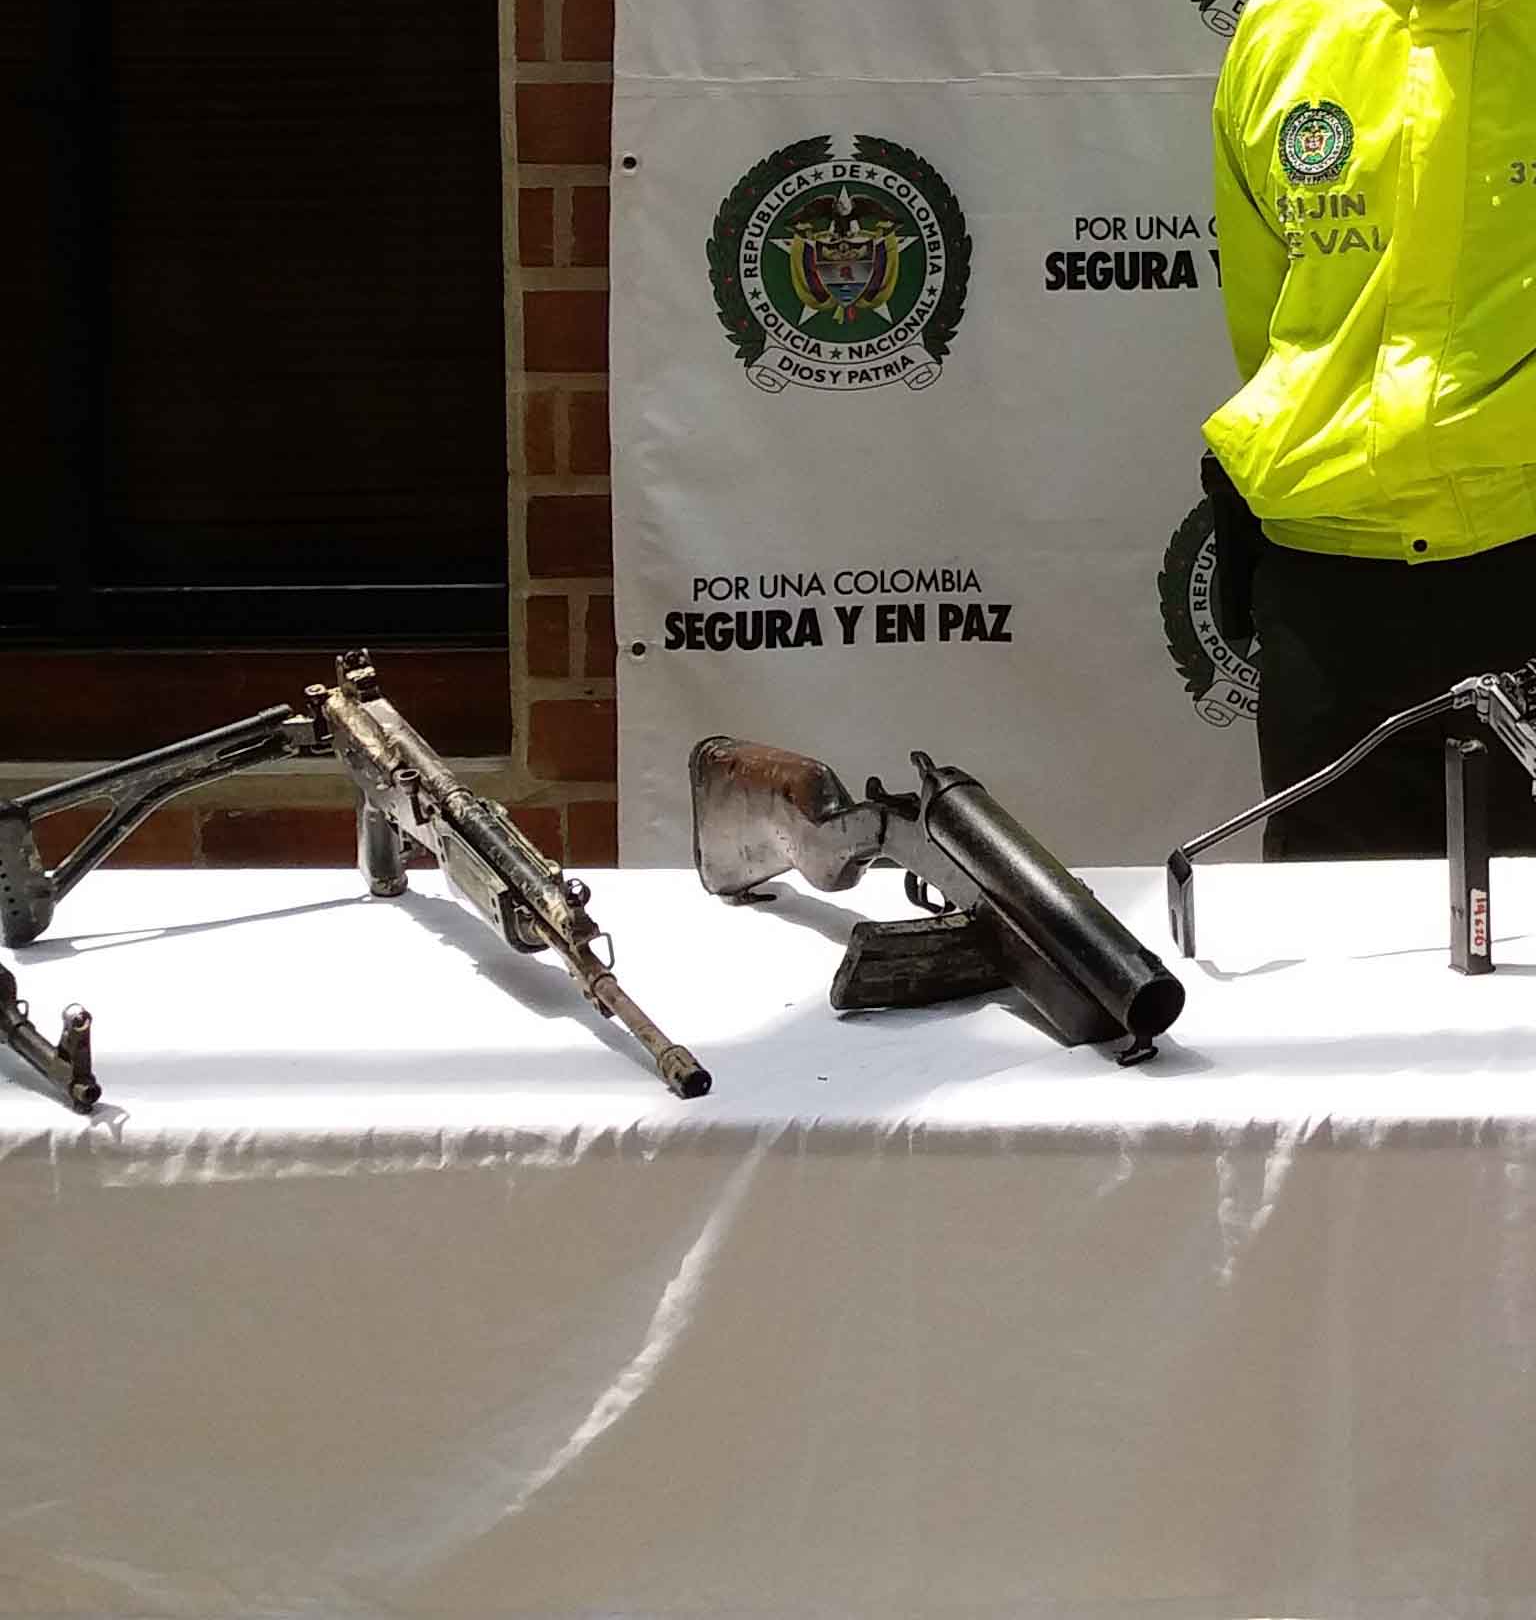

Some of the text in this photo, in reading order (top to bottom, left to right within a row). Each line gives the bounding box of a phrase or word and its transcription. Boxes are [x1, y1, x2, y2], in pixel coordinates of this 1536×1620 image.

[832, 165, 859, 179] DE
[882, 174, 944, 276] COLOMBIA
[846, 294, 936, 361] NACIONAL
[846, 356, 914, 385] PATRIA
[692, 567, 983, 603] POR UNA COLOMBIA
[663, 602, 1014, 652] SEGURA Y EN PAZ
